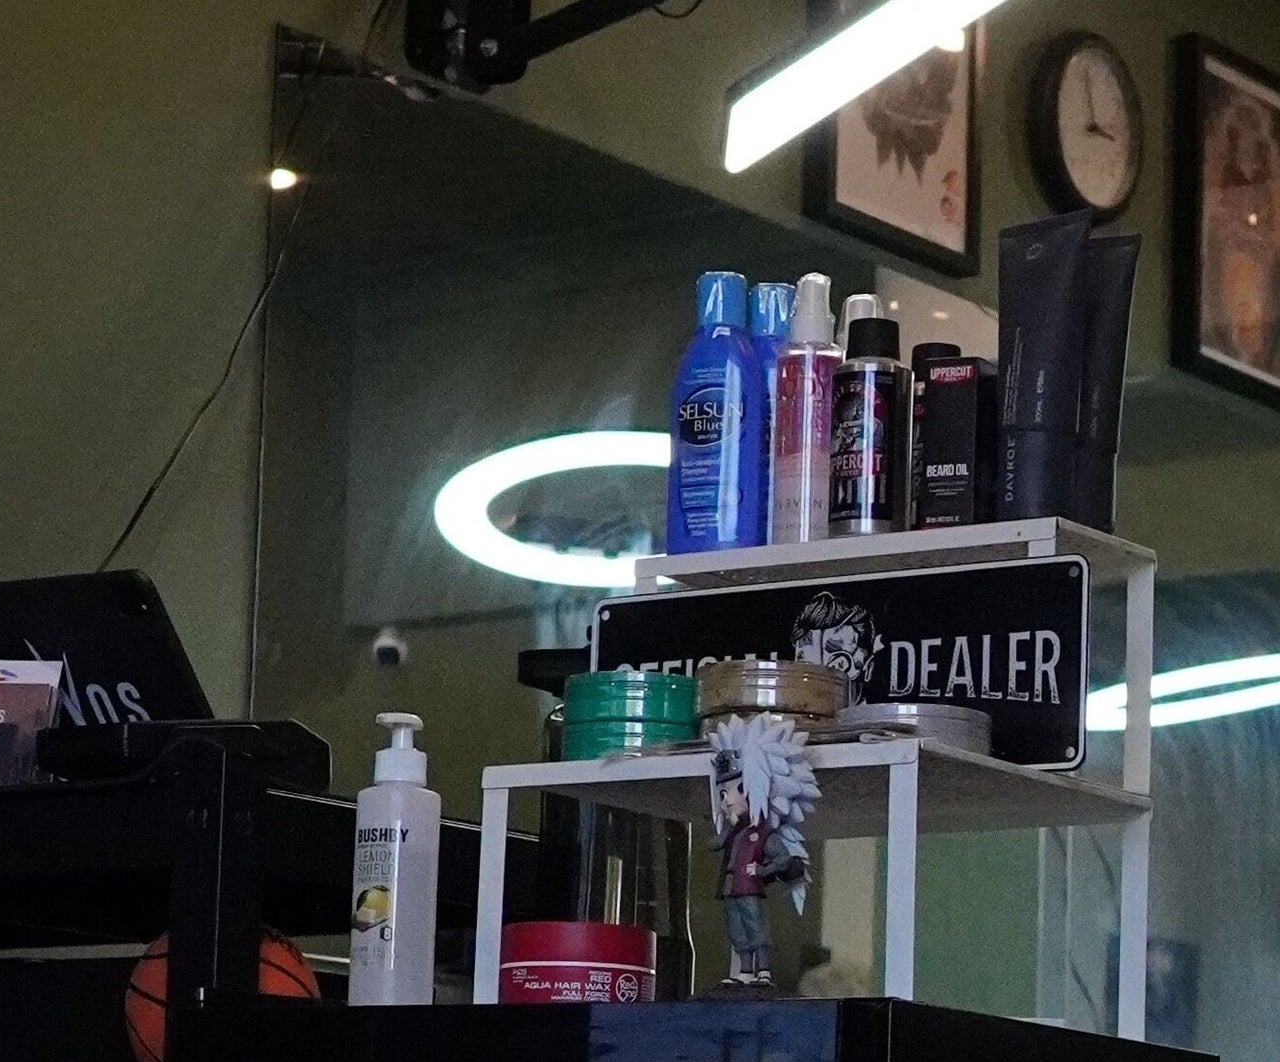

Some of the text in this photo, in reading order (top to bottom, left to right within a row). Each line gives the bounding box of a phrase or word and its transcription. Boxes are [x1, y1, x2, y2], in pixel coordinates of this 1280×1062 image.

[930, 365, 972, 380] UPPERCUT
[679, 402, 744, 421] SELSUN
[694, 419, 723, 432] Blue
[926, 463, 969, 478] BEARD OIL
[888, 629, 1062, 704] DEALER
[357, 828, 409, 844] BUSHBY
[589, 974, 612, 983] RED
[524, 981, 611, 992] AQUA HAIR WAX
